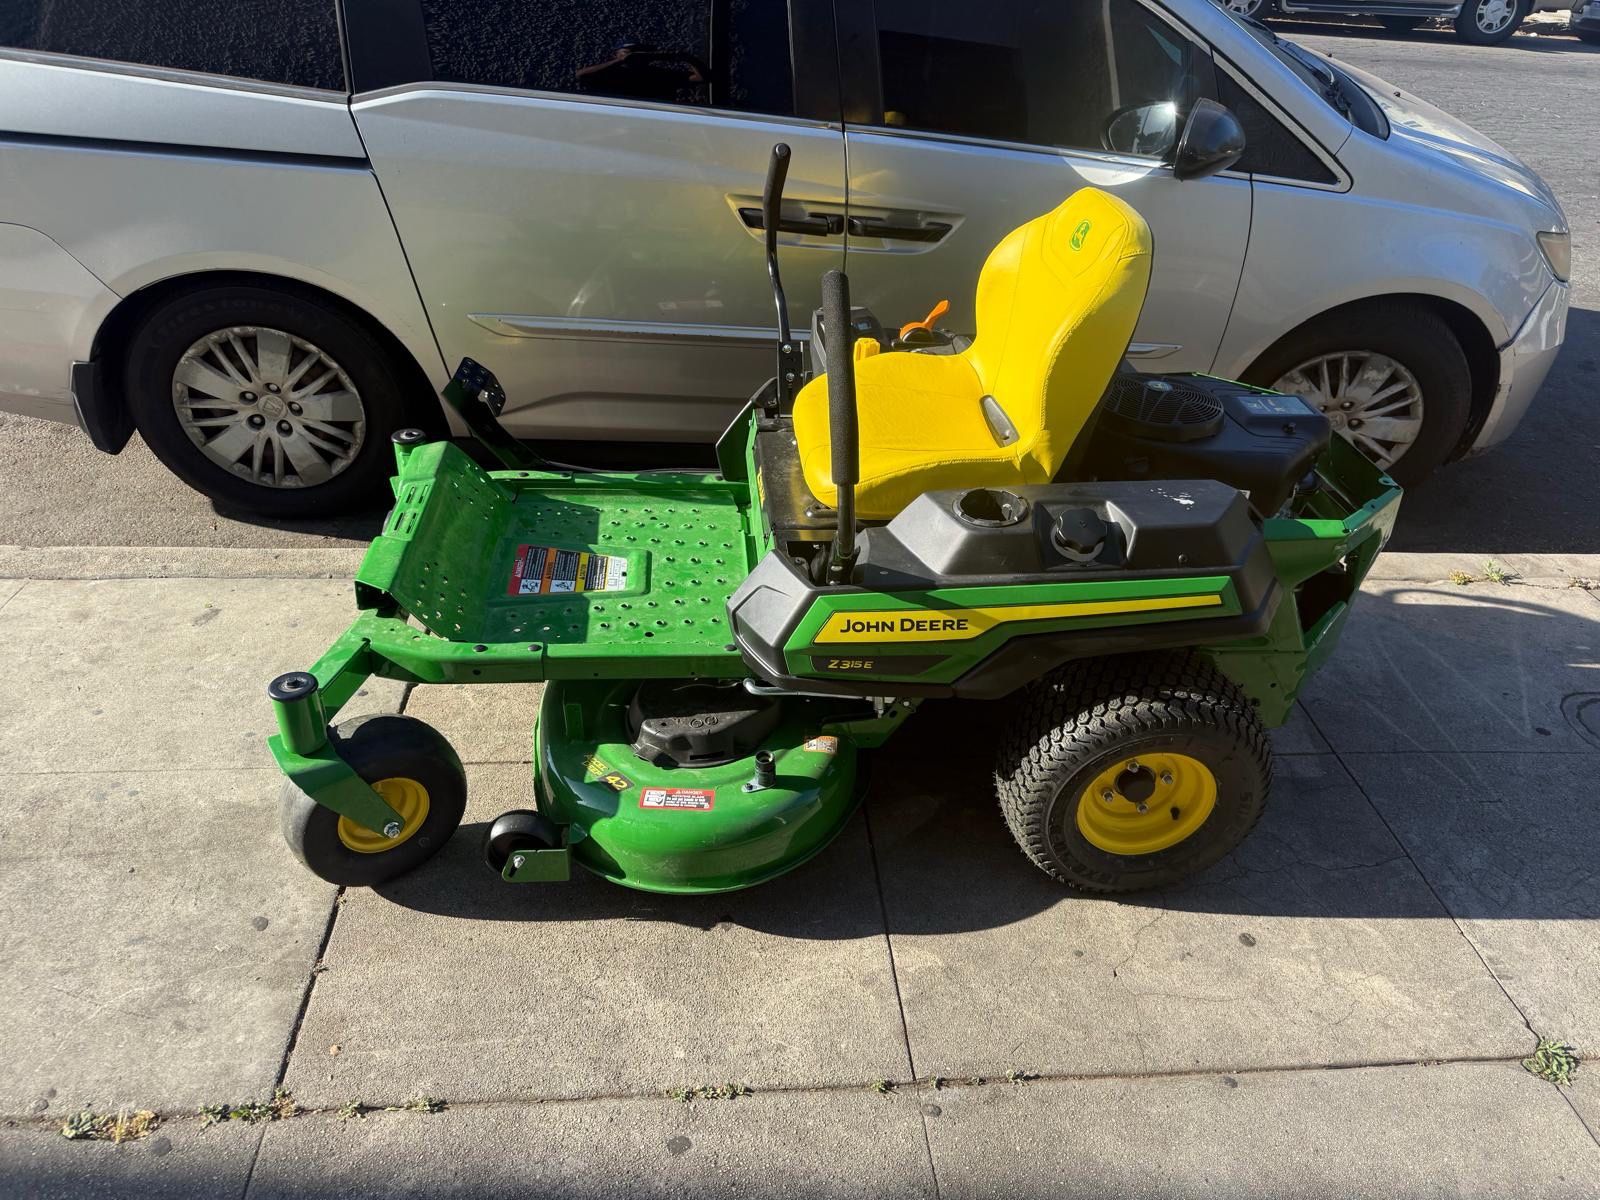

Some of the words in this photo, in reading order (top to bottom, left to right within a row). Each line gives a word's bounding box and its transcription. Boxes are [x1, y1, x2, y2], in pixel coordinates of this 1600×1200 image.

[840, 619, 895, 633] JOHN
[900, 618, 969, 632] DEERE
[605, 775, 628, 790] 42
